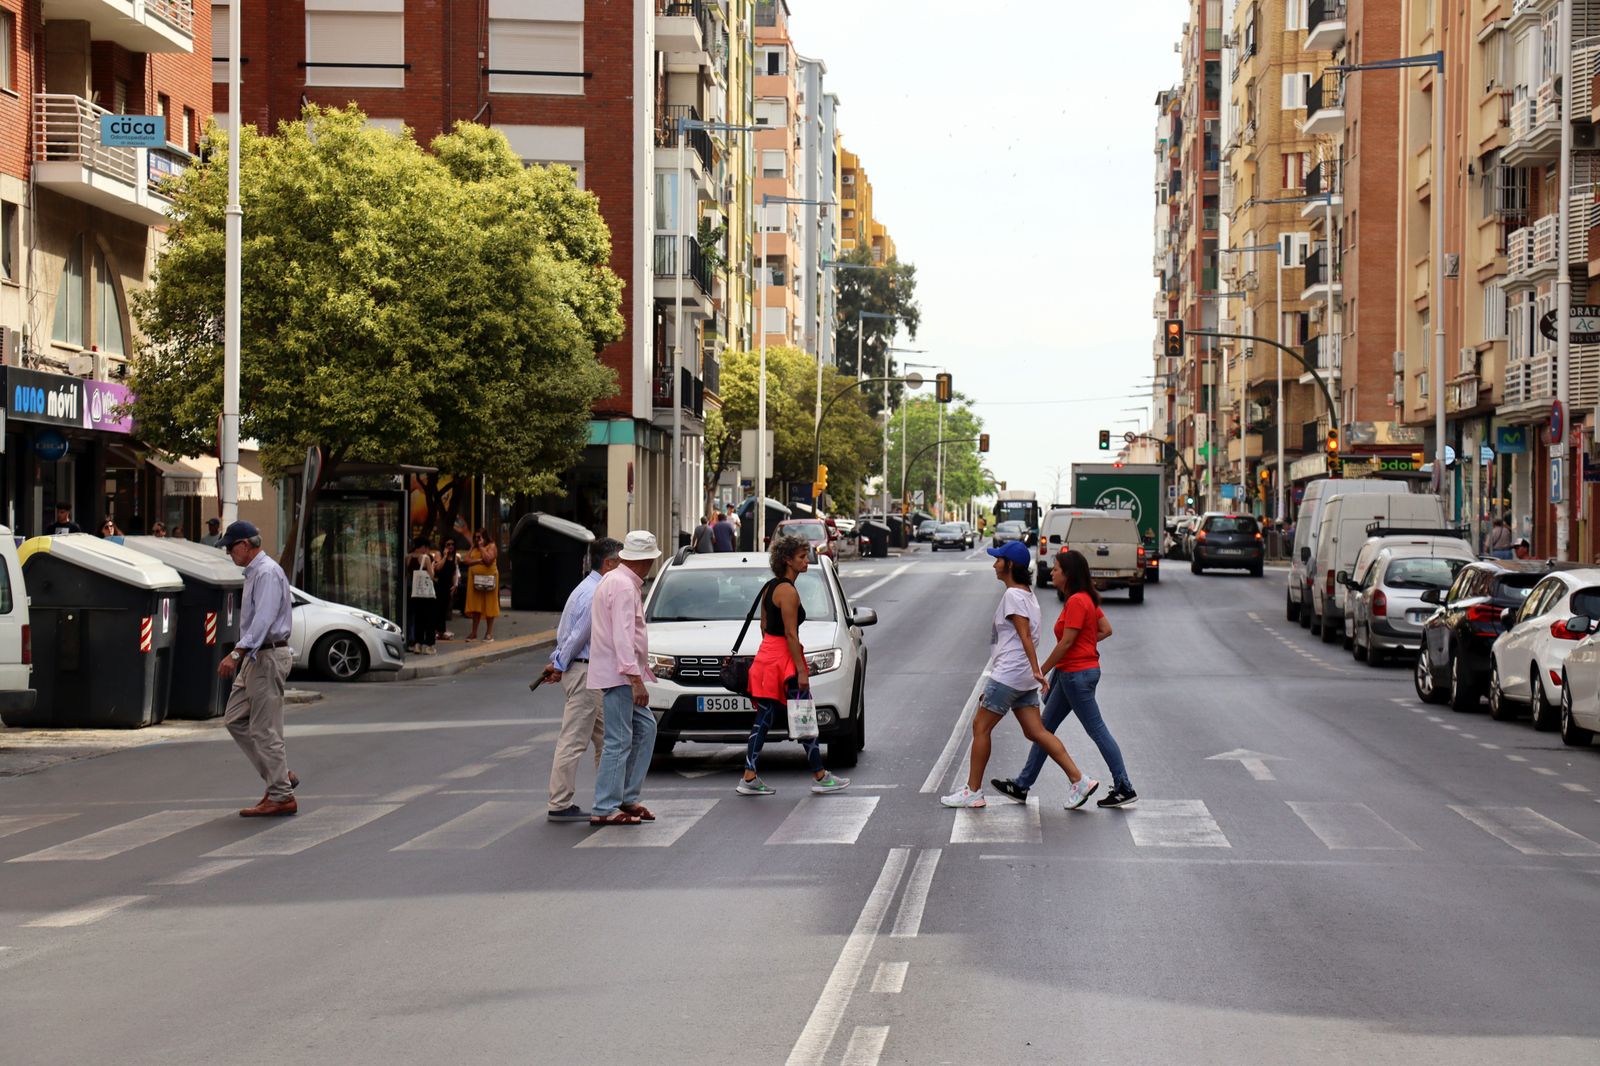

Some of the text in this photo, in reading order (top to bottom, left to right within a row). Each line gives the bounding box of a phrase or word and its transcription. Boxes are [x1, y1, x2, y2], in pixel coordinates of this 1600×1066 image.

[15, 385, 45, 415] nuno
[47, 383, 78, 419] móvil
[706, 698, 738, 711] 9508
